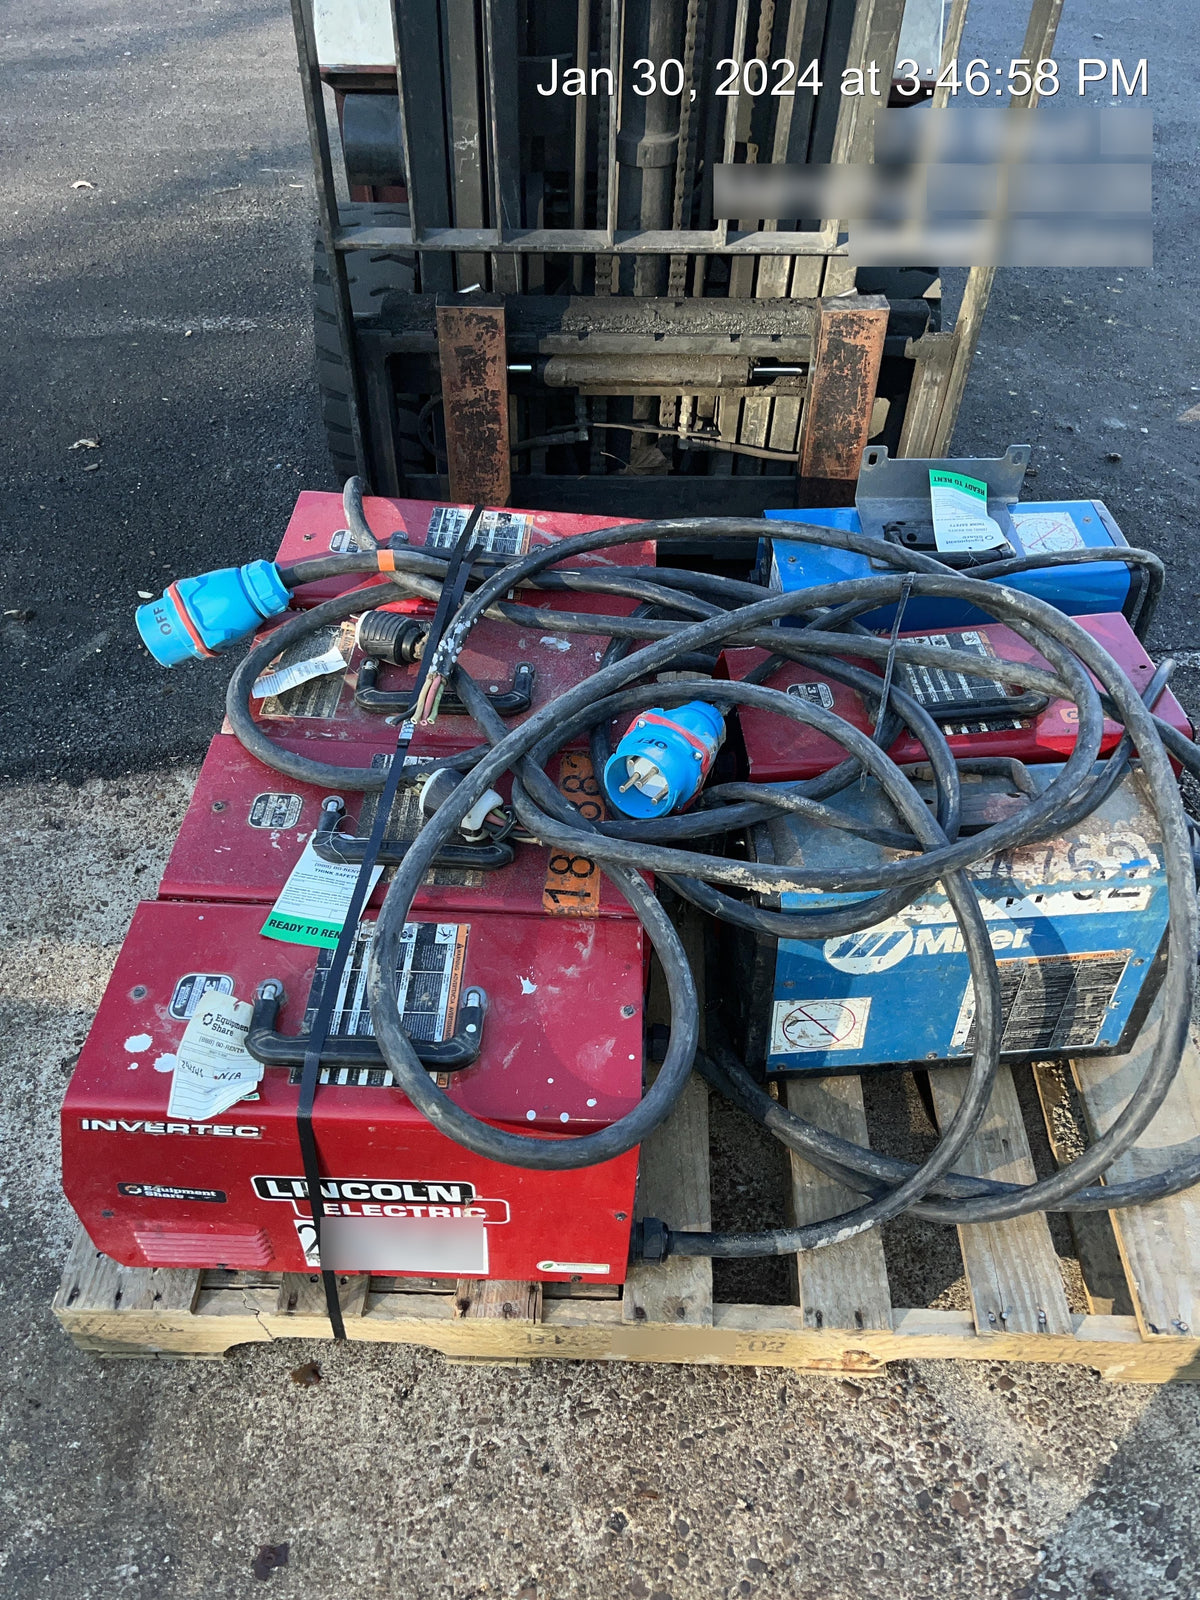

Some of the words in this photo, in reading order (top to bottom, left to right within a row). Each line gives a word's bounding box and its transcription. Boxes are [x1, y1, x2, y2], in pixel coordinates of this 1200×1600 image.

[965, 483, 985, 496] READY
[153, 607, 172, 636] OFF
[268, 919, 304, 933] READY
[306, 925, 319, 936] TO
[320, 929, 341, 940] REN
[913, 926, 1034, 956] Mier
[211, 1022, 234, 1036] Share
[215, 1013, 249, 1033] Equipmen
[81, 1119, 260, 1137] INVERTEC
[143, 1185, 217, 1197] Equipment
[144, 1191, 185, 1199] Share
[265, 1180, 462, 1203] LINCOLN
[322, 1203, 487, 1220] ELECTRIC
